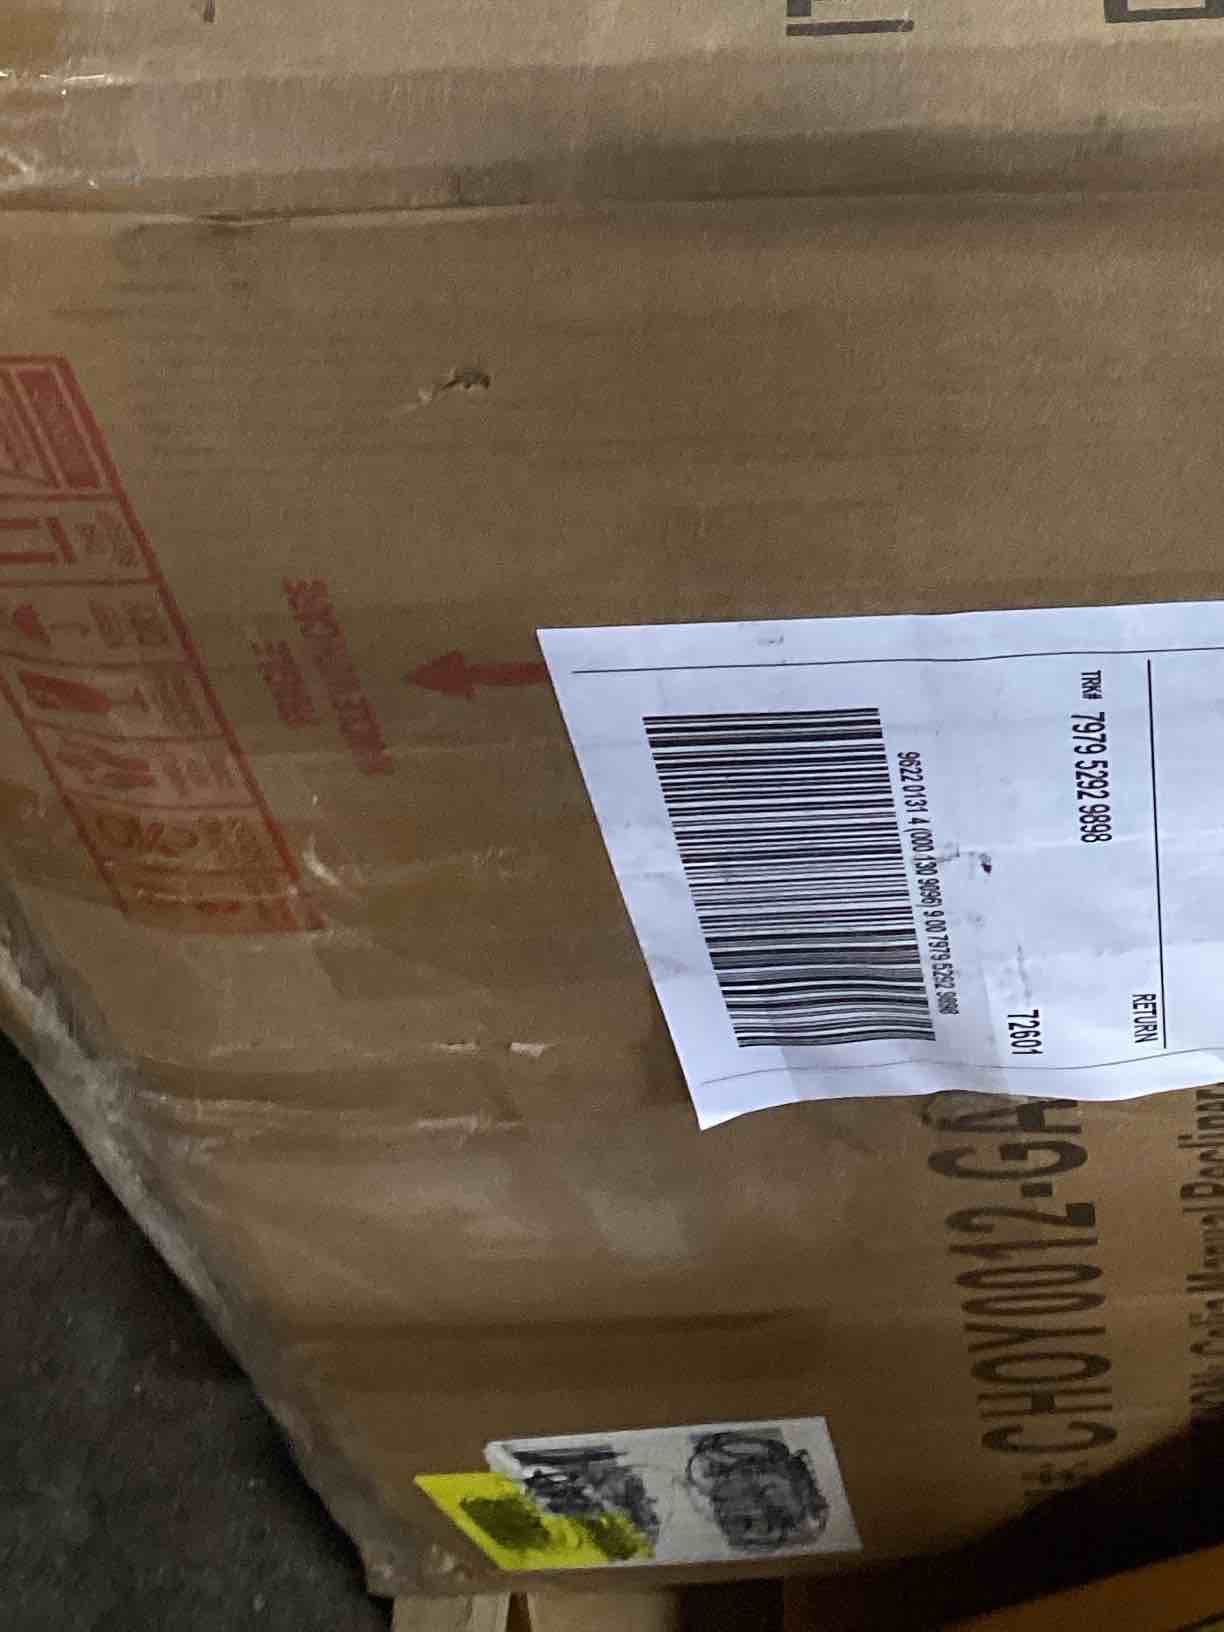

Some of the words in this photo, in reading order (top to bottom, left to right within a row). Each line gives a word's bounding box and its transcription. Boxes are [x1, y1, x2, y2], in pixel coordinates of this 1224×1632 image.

[1081, 669, 1104, 702] TRK#
[1071, 712, 1106, 755] 7979
[898, 751, 924, 781] 9622
[1075, 759, 1109, 800] 5292
[903, 784, 930, 814] 0131
[1079, 803, 1112, 844] 9898
[1008, 1009, 1043, 1056] 72601
[1132, 992, 1158, 1044] RETURN
[924, 1096, 1118, 1454] CHOY0012-GA
